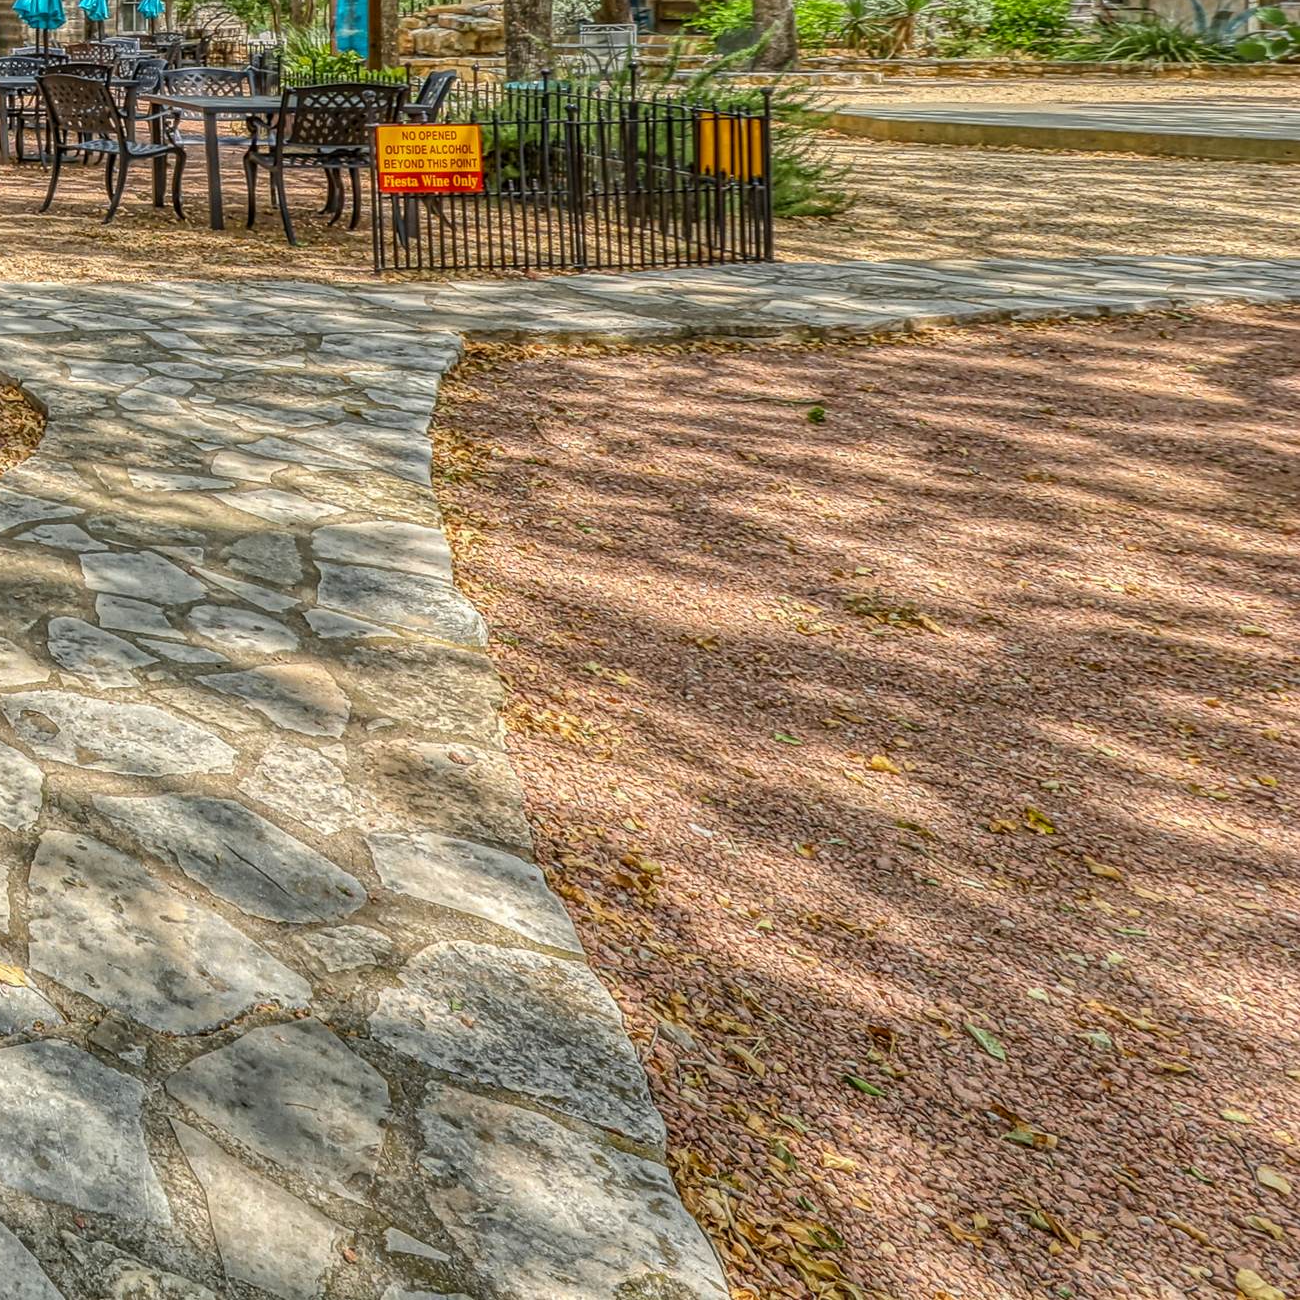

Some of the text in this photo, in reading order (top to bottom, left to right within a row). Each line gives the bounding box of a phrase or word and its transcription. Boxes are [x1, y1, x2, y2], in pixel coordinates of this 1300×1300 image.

[401, 130, 457, 140] NO OPENED
[385, 144, 474, 155] OUTSIDE ALCOHOL
[384, 158, 477, 169] BEYOND THIS POINT
[383, 174, 478, 189] Fiesta Wine Only
